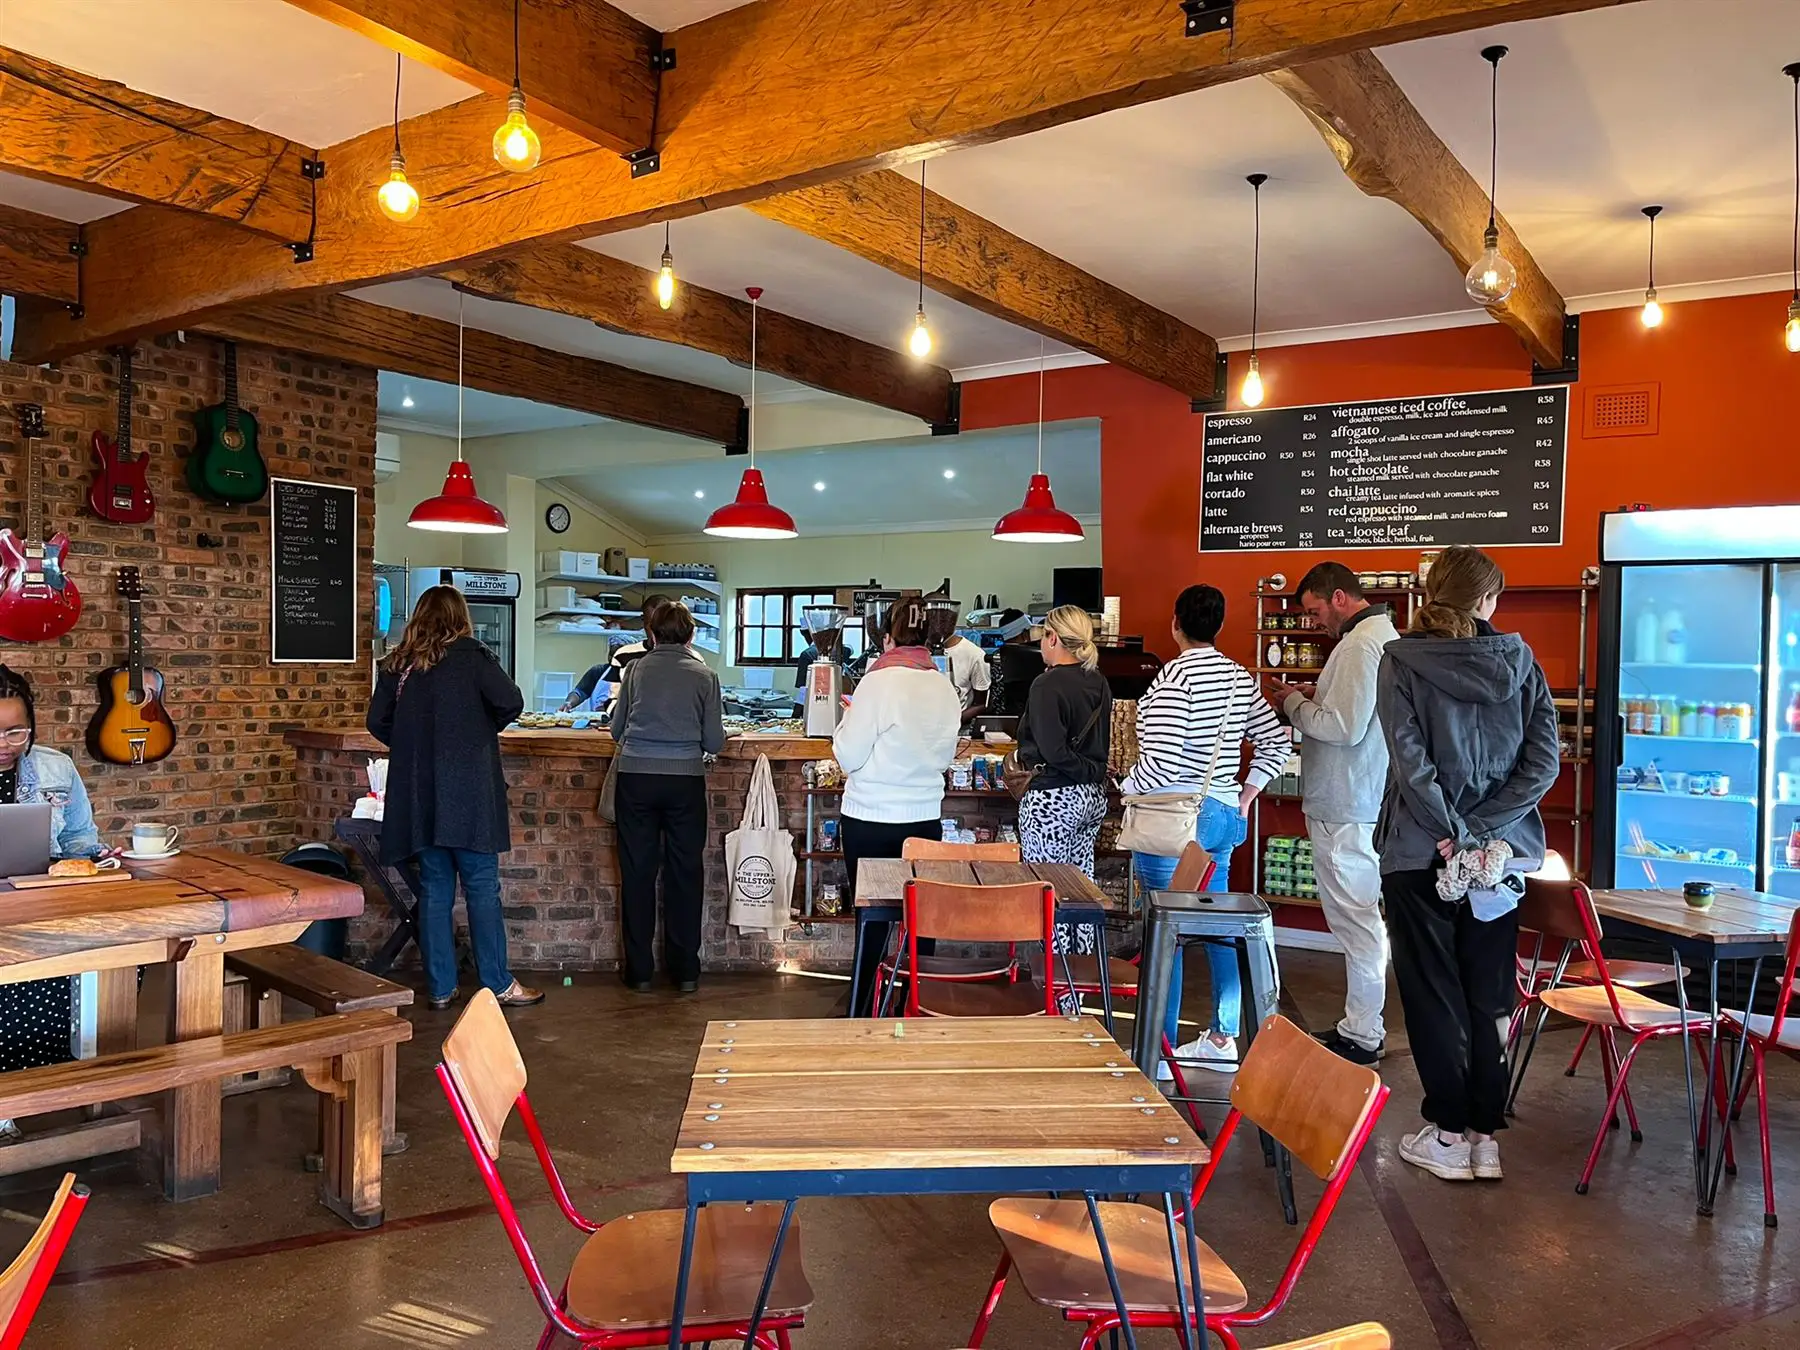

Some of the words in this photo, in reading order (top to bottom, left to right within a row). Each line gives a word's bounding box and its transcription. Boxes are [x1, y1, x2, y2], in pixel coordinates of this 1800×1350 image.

[1332, 405, 1397, 418] vietnamese
[1400, 401, 1424, 413] iced
[1428, 398, 1466, 411] coffee
[1451, 407, 1490, 417] condensed
[1492, 405, 1508, 413] milk
[1208, 416, 1252, 429] espresso
[1331, 426, 1380, 439] affogato
[1537, 416, 1554, 425] R45
[1207, 434, 1262, 445] americano
[1353, 437, 1377, 445] scoops
[1379, 435, 1386, 443] of
[1387, 434, 1409, 442] vanilla
[1444, 430, 1459, 438] and
[1460, 428, 1481, 439] single
[1482, 428, 1514, 437] espresso
[1331, 446, 1369, 458] mocha
[1536, 439, 1552, 448] R42
[1399, 452, 1421, 460] served
[1440, 449, 1475, 458] chocolate
[1476, 448, 1508, 458] ganache
[1207, 451, 1266, 464] cappuccino
[1330, 466, 1349, 477] hot
[1352, 463, 1409, 475] chocolate
[1347, 474, 1375, 482] steamed
[1376, 473, 1390, 481] milk
[1432, 469, 1468, 479] chocolate
[1469, 468, 1500, 478] ganache
[1207, 471, 1222, 483] flat
[1226, 470, 1254, 481] white
[1205, 488, 1245, 499] cortado
[1328, 486, 1352, 497] chai
[1354, 485, 1381, 496] latte
[1399, 491, 1424, 499] infused
[1443, 490, 1475, 498] aromatic
[1477, 489, 1500, 497] spices
[1205, 506, 1228, 517] latte
[1328, 505, 1347, 516] red
[1349, 504, 1417, 517] cappuccino
[1404, 513, 1432, 521] steamed
[1451, 511, 1464, 519] and
[1204, 524, 1250, 535] alternate
[1252, 523, 1283, 533] brews
[1327, 528, 1344, 537] tea
[1354, 526, 1384, 537] loose
[1387, 524, 1410, 536] leaf
[465, 581, 507, 589] MILLSTONE
[735, 876, 776, 884] MILLSTONE
